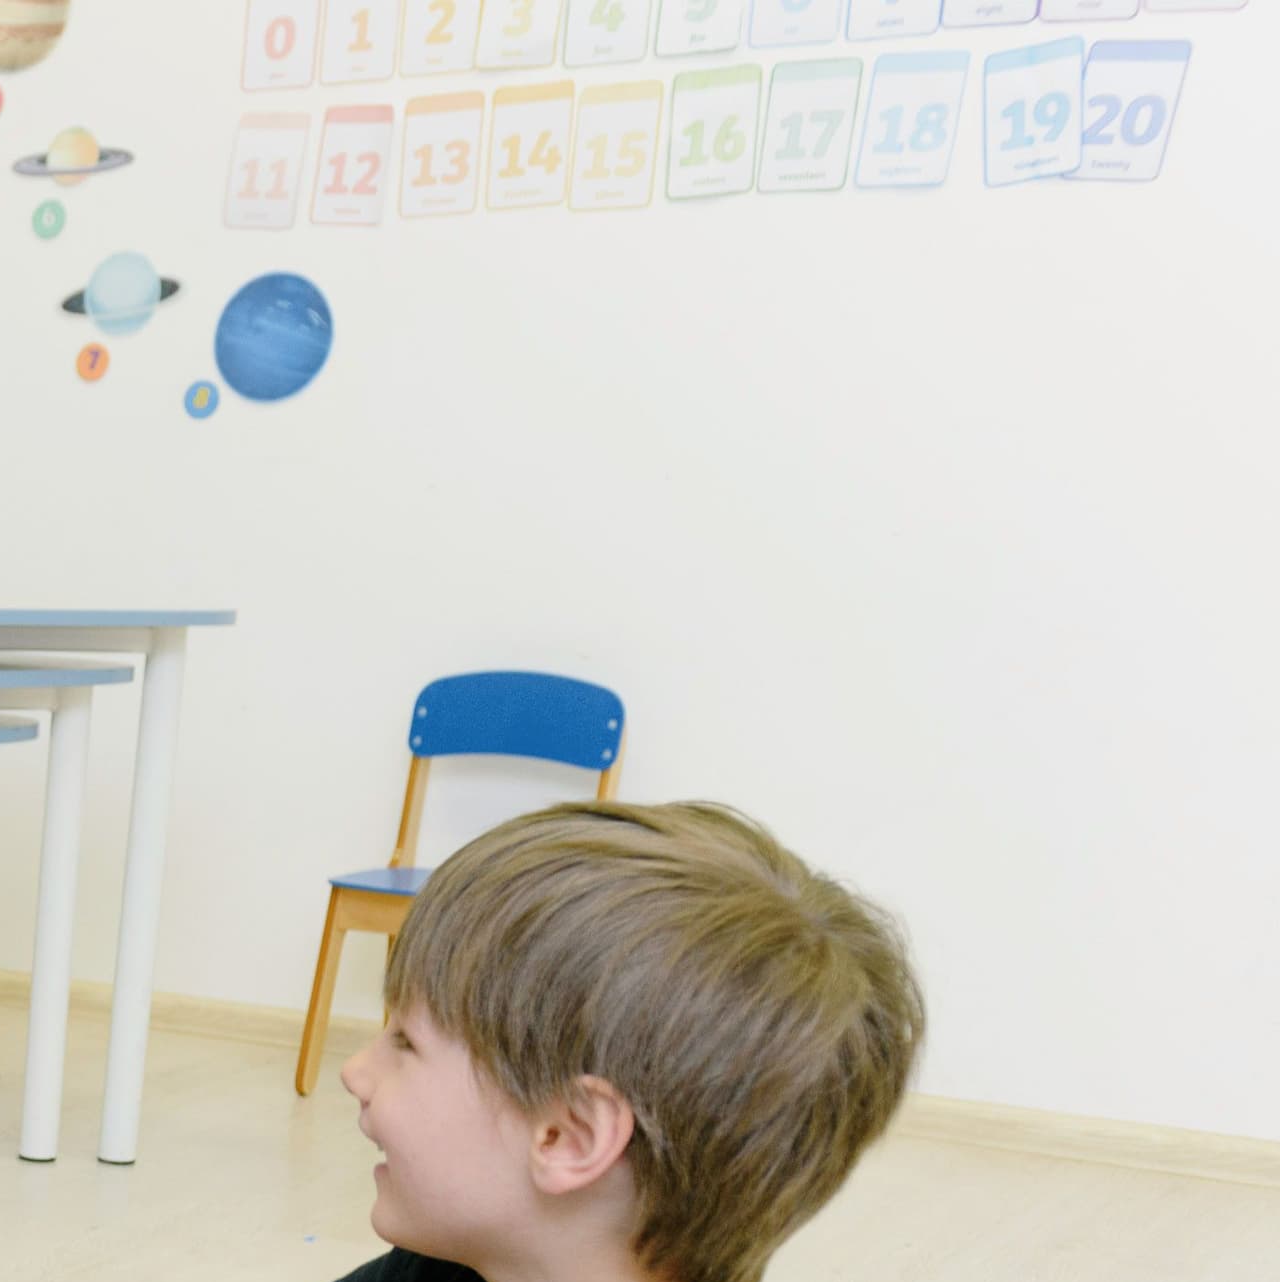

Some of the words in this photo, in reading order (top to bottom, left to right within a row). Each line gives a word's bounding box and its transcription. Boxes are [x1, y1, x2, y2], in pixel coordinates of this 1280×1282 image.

[262, 15, 297, 61] 0
[345, 7, 375, 53] 1
[424, 0, 457, 46] 2
[501, 0, 536, 38] 3
[588, 0, 626, 33] 4
[678, 112, 747, 168] 16
[774, 109, 847, 161] 17
[871, 101, 951, 154] 18
[998, 89, 1071, 151] 19
[1081, 93, 1168, 147] 20
[236, 157, 289, 201] 11
[322, 150, 383, 196] 12
[410, 137, 472, 188] 13
[496, 128, 562, 180] 14
[581, 128, 649, 180] 15
